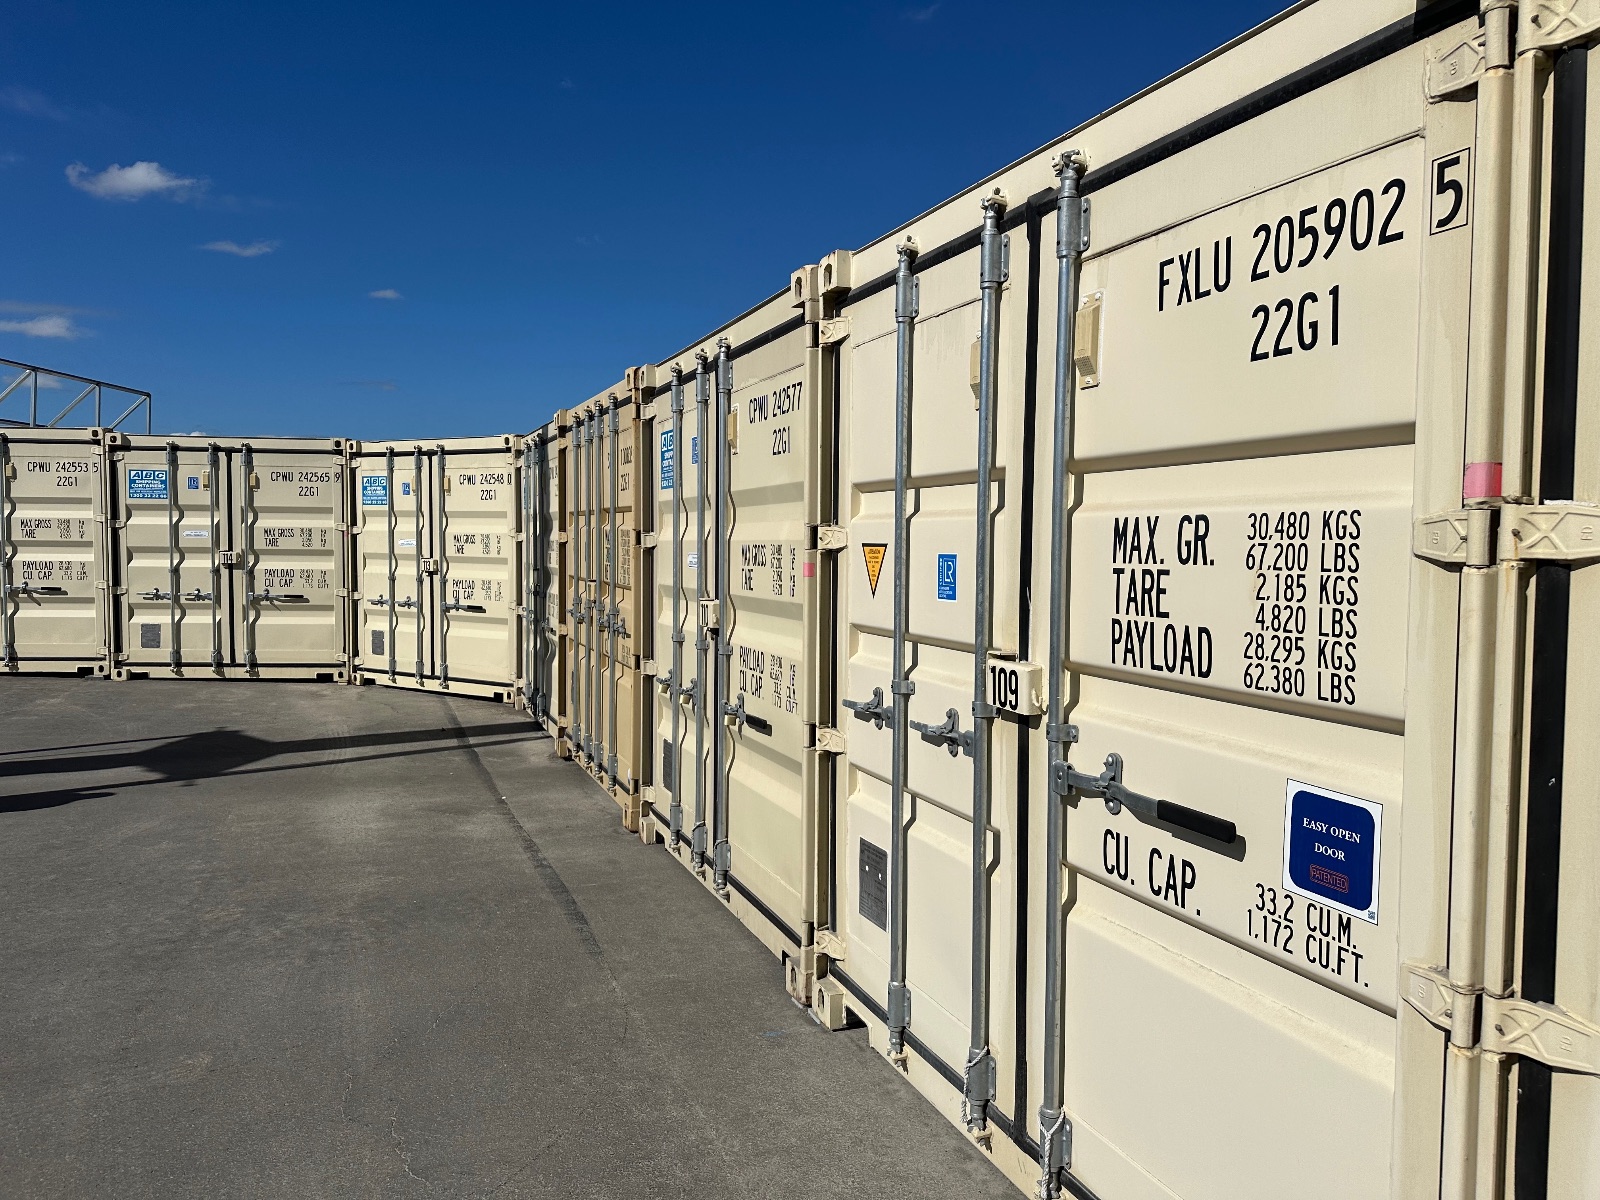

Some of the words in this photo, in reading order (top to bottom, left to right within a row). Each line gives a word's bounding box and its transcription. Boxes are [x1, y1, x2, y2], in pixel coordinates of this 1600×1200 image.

[1158, 235, 1232, 312] FXLU
[1250, 178, 1406, 282] 205902
[1435, 155, 1464, 229] 5
[1250, 284, 1340, 362] 22G1
[748, 394, 769, 424] CPWU
[772, 381, 802, 418] 242577
[772, 426, 791, 455] 22G1
[27, 461, 51, 472] CPWU
[55, 462, 89, 473] 242553
[93, 462, 99, 473] 5
[56, 476, 78, 487] 22G1
[130, 470, 166, 480] ABC
[270, 471, 294, 482] CPWU
[298, 472, 330, 482] 242565
[335, 472, 341, 482] 9
[363, 477, 386, 486] ABC
[459, 474, 476, 485] CPWU
[480, 473, 504, 485] 242548
[298, 486, 320, 497] 22G1
[481, 489, 497, 500] 22G1
[20, 518, 33, 528] MAX
[34, 518, 51, 529] GROSS
[20, 528, 36, 539] TARE
[263, 527, 276, 538] MAX
[277, 528, 295, 538] GROSS
[1112, 516, 1165, 565] MAX.
[1177, 513, 1215, 566] GR.
[1247, 511, 1310, 541] 30,480
[1321, 509, 1362, 541] KGS
[264, 537, 279, 548] TARE
[453, 544, 464, 554] TARE
[22, 560, 54, 571] PAYLOAD
[222, 553, 233, 564] 114
[422, 560, 431, 571] 113
[1246, 542, 1308, 572] 67,200
[1320, 542, 1360, 574] LBS
[264, 568, 295, 578] PAYLOAD
[741, 568, 754, 591] TARE
[279, 578, 295, 588] CAP.
[452, 579, 476, 590] PAYLOAD
[1112, 567, 1171, 619] TARE
[1255, 572, 1307, 603] 2,185
[1319, 574, 1359, 606] KGS
[1255, 603, 1306, 634] 4,820
[1318, 606, 1358, 639] LBS
[1111, 617, 1213, 679] PAYLOAD
[1243, 631, 1306, 666] 28,295
[1317, 639, 1357, 672] KGS
[739, 645, 765, 675] PAYLOAD
[739, 669, 749, 693] CU.
[750, 673, 765, 700] CAP.
[990, 665, 1018, 711] 109
[1243, 662, 1306, 697] 62,380
[1317, 671, 1356, 705] LBS
[1302, 817, 1328, 833] EASY
[1330, 826, 1360, 844] OPEN
[1314, 842, 1345, 861] DOOR
[1311, 867, 1347, 890] PATENTED
[1103, 828, 1135, 886] CU.
[1148, 847, 1201, 917] CAP.
[1255, 882, 1294, 924] 33.2
[1305, 903, 1357, 949] CU.M.
[1304, 934, 1370, 988] CU.FT.
